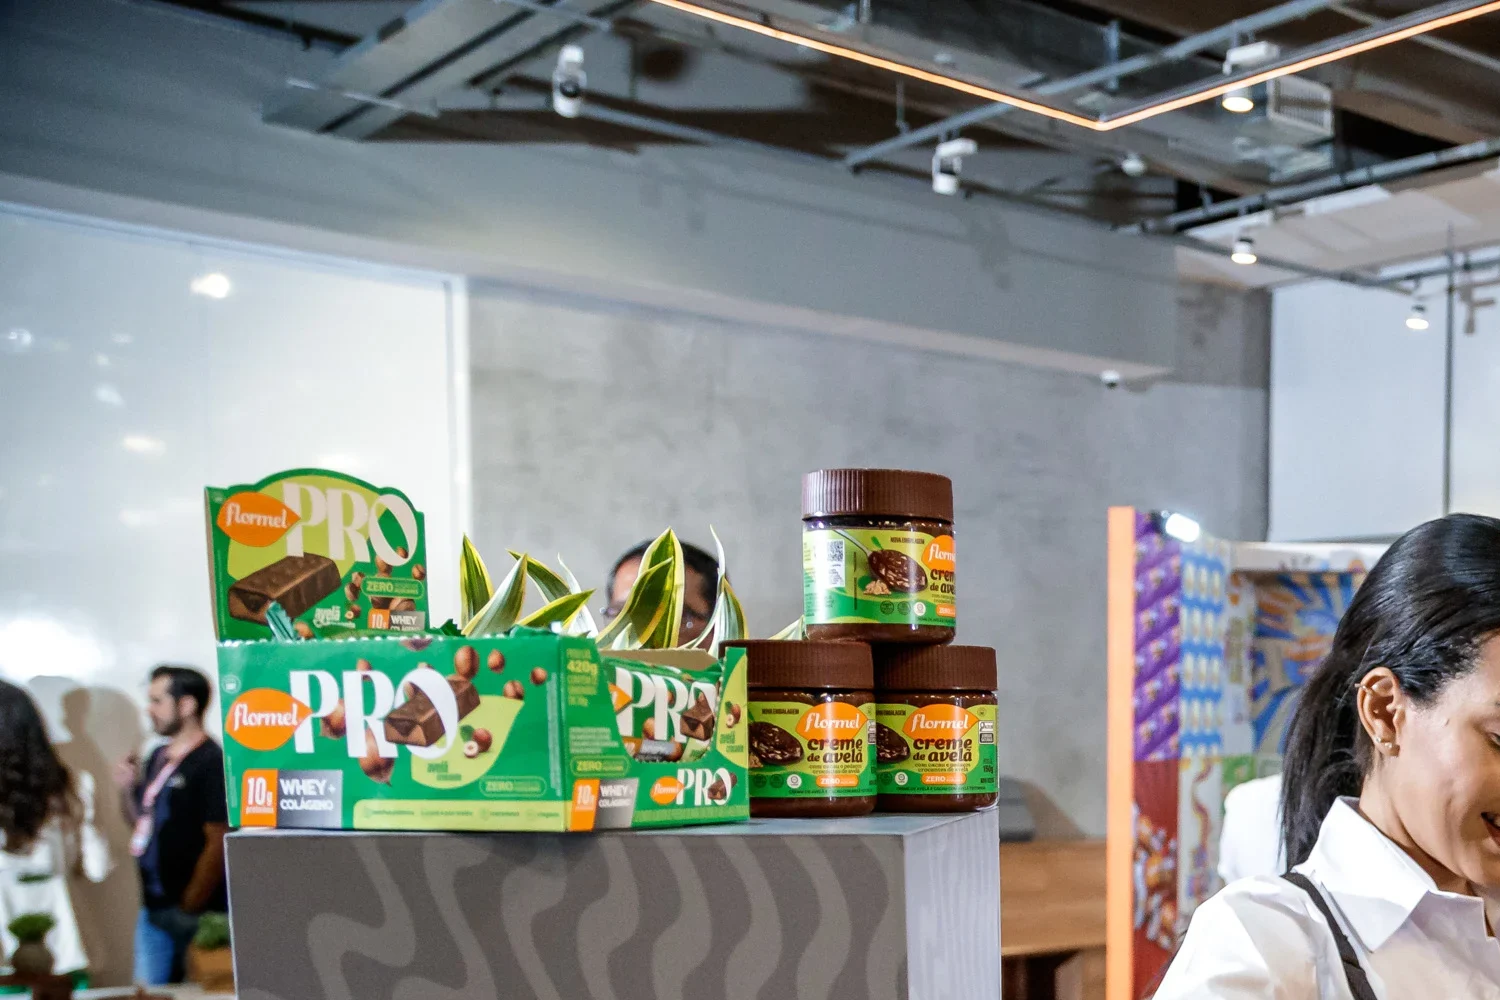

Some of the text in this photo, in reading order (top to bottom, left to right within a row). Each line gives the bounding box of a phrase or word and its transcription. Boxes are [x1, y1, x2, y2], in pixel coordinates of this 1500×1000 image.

[226, 502, 288, 529] flormel
[282, 481, 418, 566] PRO
[366, 580, 394, 593] ZERO
[233, 703, 299, 732] flormel
[289, 668, 459, 760] PRO
[804, 712, 860, 733] flormel
[911, 714, 969, 733] flormel
[807, 738, 863, 752] creme
[913, 738, 972, 750] creme
[807, 748, 863, 764] de avelã
[913, 748, 972, 762] de avelã
[676, 768, 732, 806] PRO
[820, 777, 841, 785] ZERO
[246, 776, 274, 807] 10g
